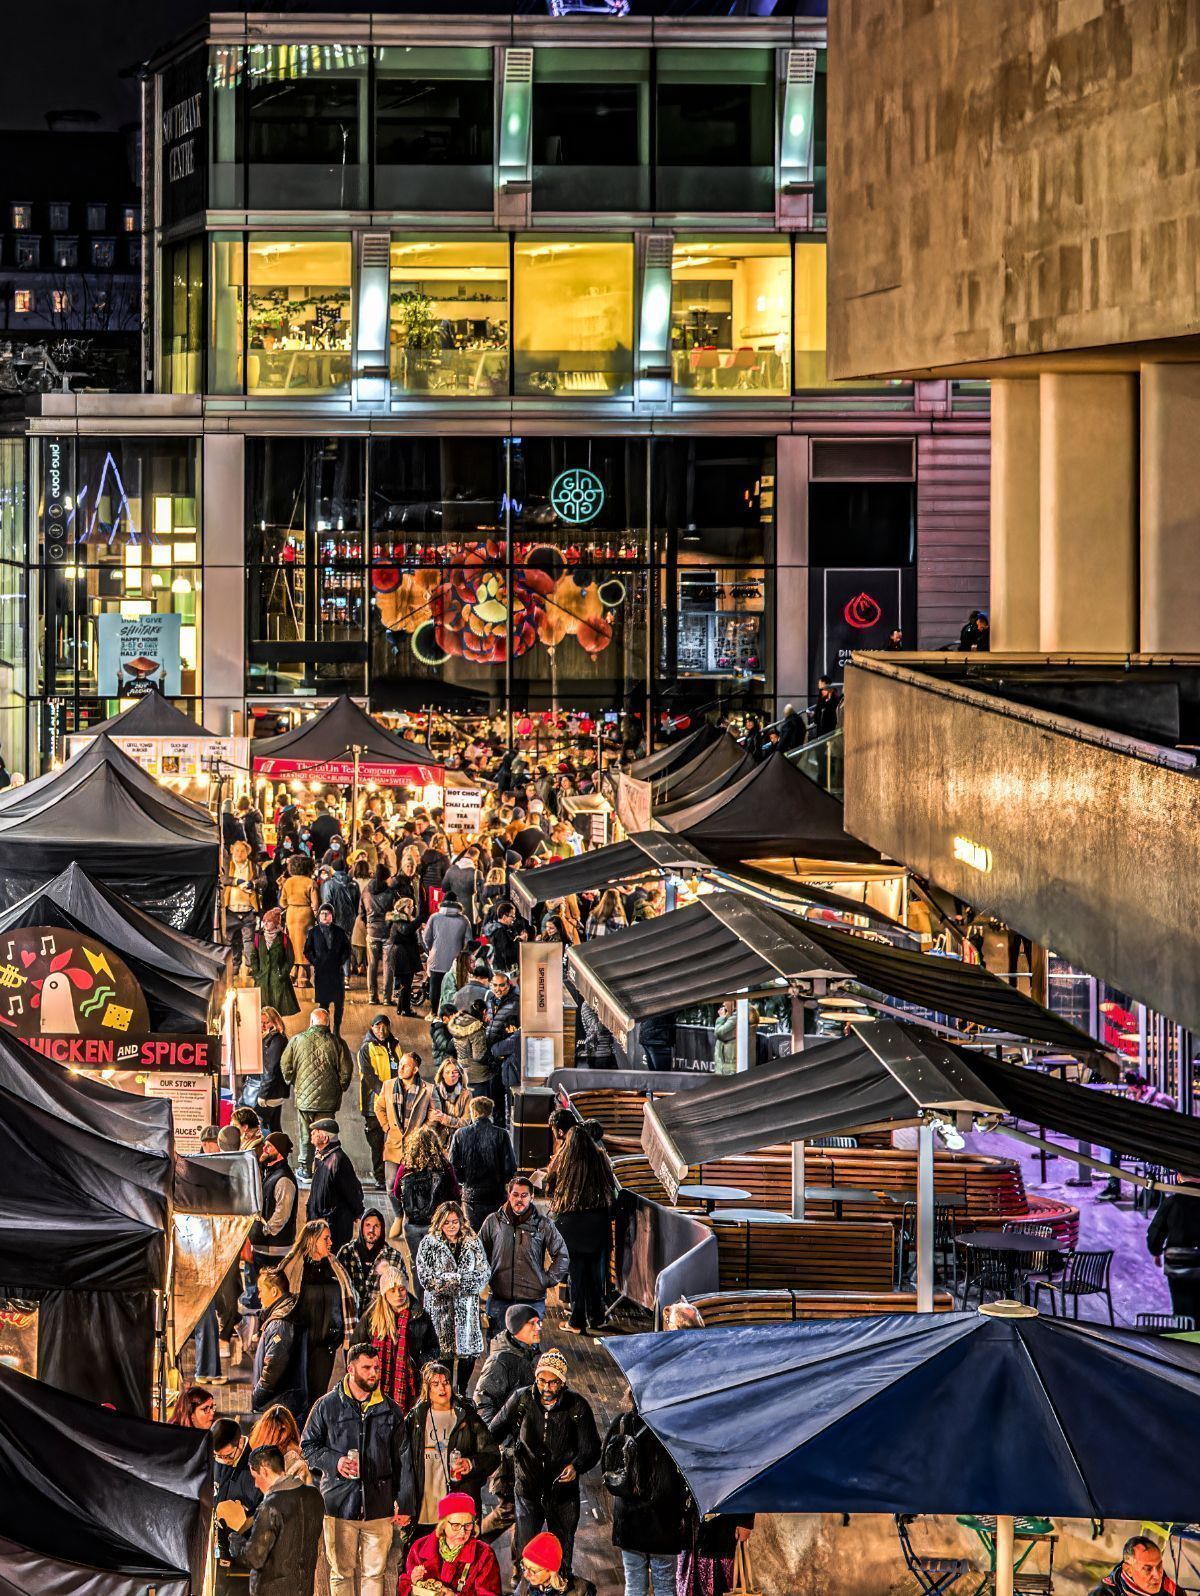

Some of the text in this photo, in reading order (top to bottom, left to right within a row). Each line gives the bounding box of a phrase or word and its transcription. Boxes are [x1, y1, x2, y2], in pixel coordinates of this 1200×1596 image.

[358, 766, 397, 776] Company
[117, 1044, 138, 1058] AND
[140, 1041, 209, 1066] SPICE
[642, 1054, 716, 1072] SITLAND
[175, 1128, 197, 1136] AUCES
